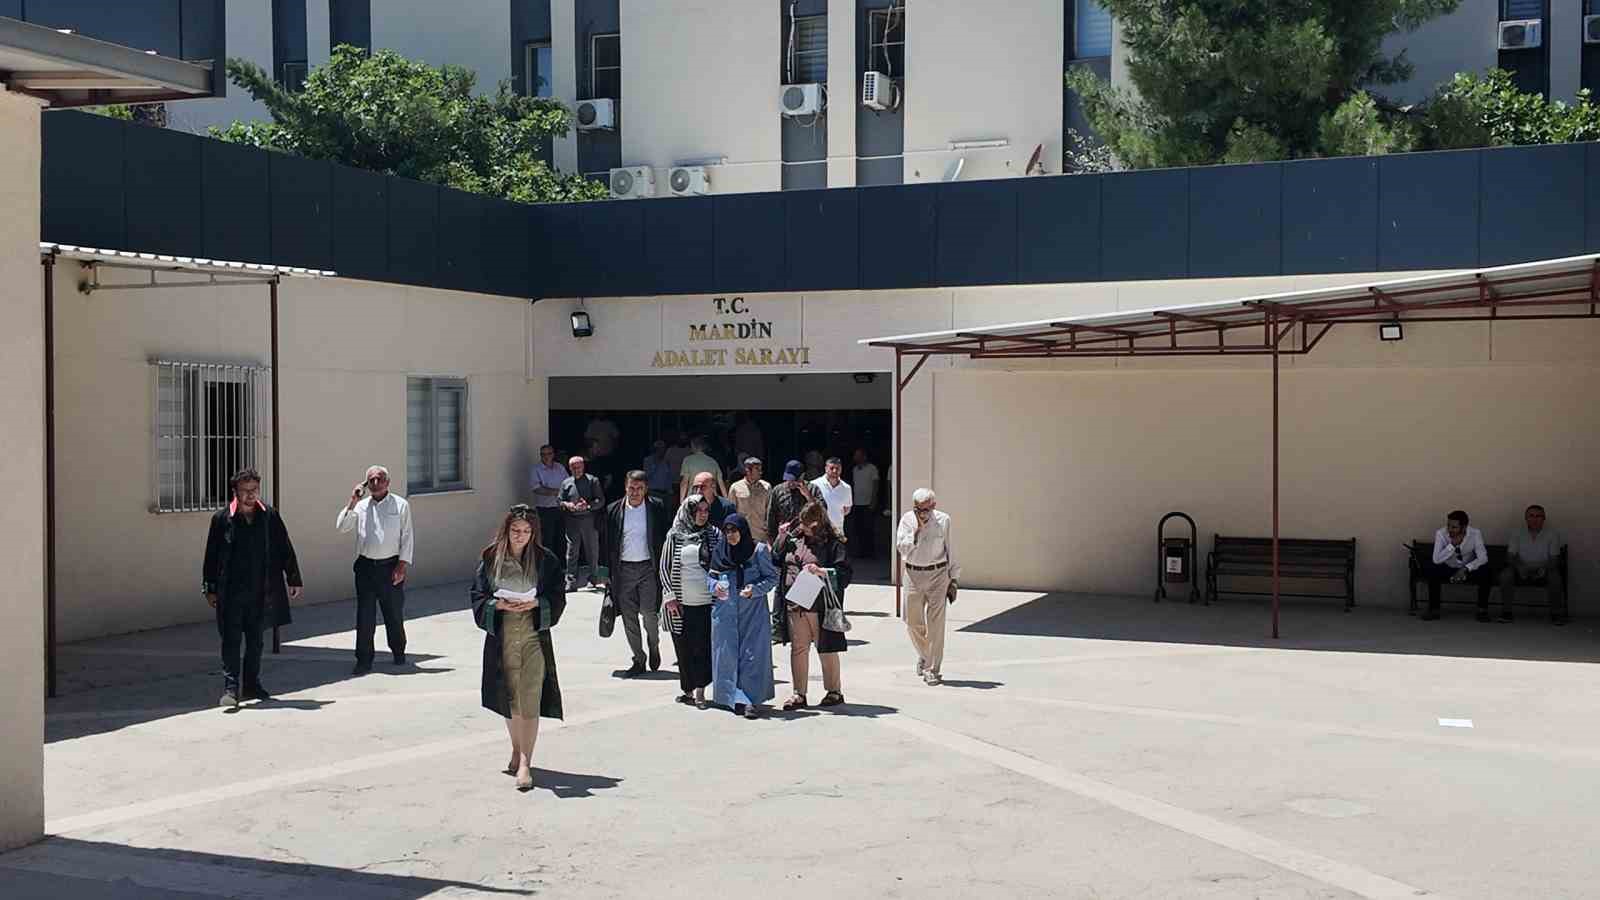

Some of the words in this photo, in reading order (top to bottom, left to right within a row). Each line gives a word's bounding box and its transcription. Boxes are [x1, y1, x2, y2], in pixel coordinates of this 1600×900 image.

[713, 297, 749, 314] T.C.
[689, 318, 773, 341] MARDİN
[651, 349, 728, 368] ADALET
[735, 347, 811, 366] SARAYI
